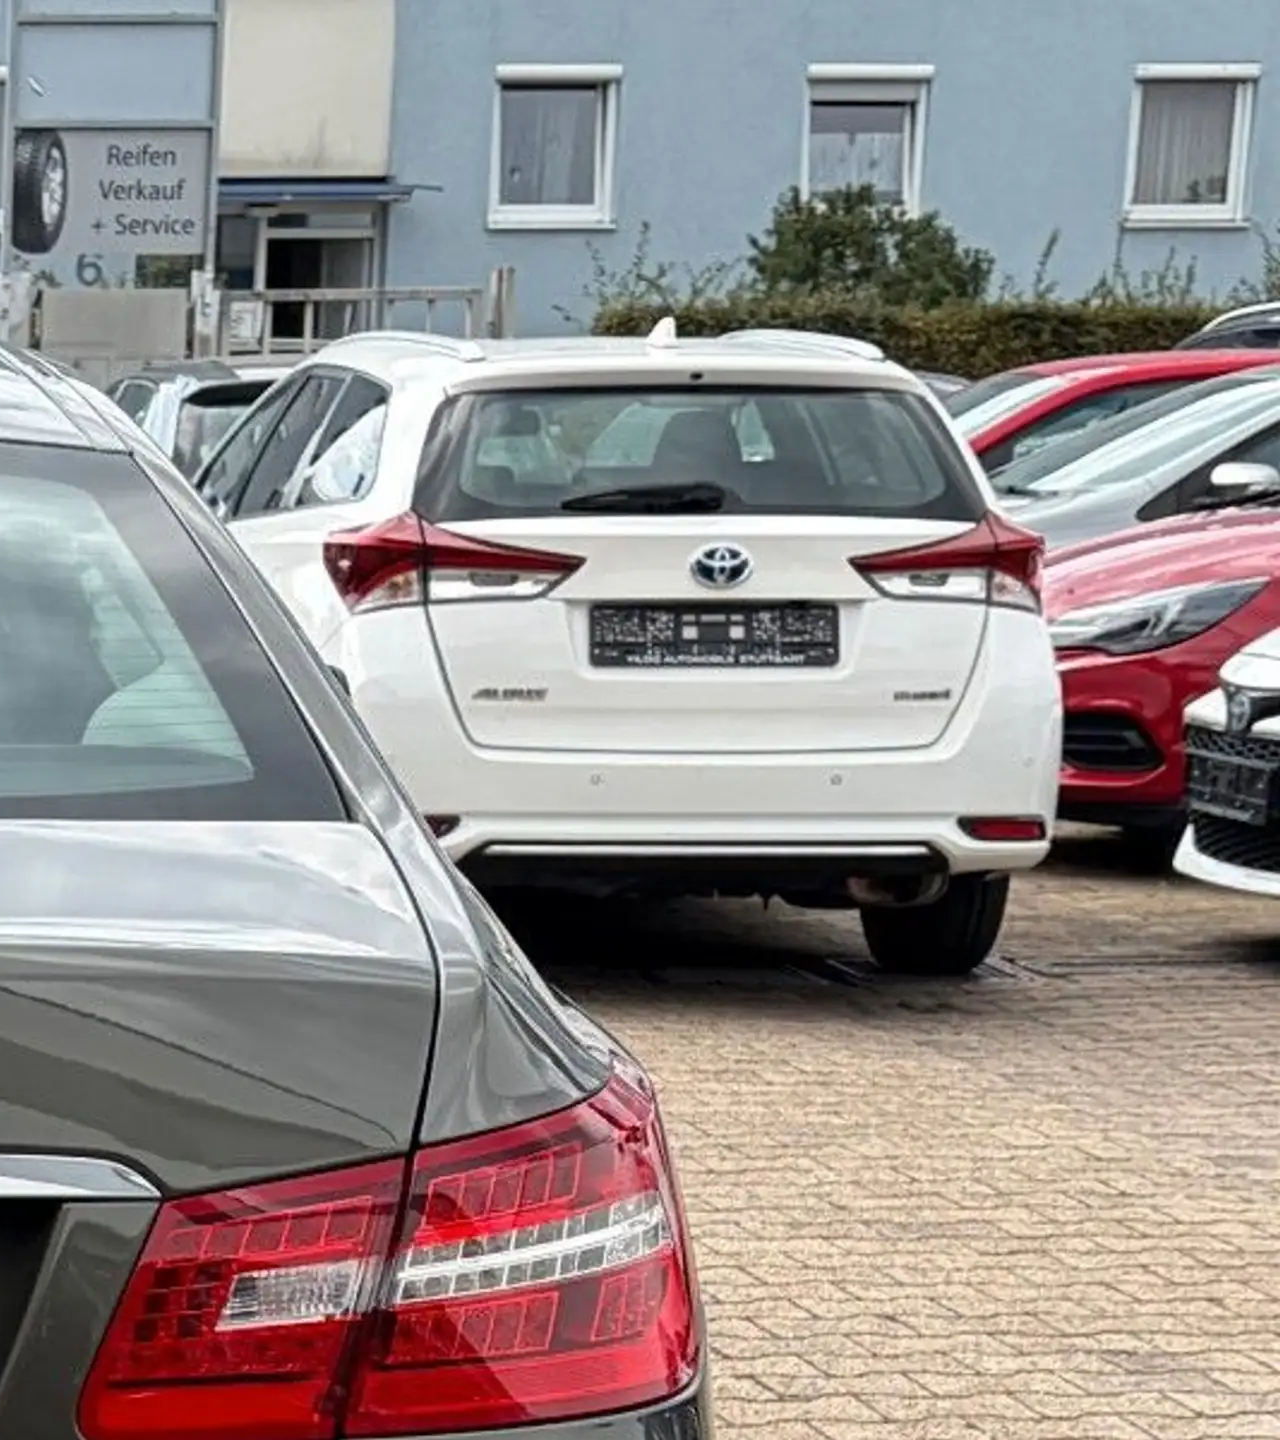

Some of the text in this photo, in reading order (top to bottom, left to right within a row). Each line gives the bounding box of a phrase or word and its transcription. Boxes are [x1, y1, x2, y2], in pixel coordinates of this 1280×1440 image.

[107, 143, 177, 167] Reifen
[98, 177, 187, 201] Verkauf
[114, 213, 196, 236] Service
[76, 253, 103, 287] 6
